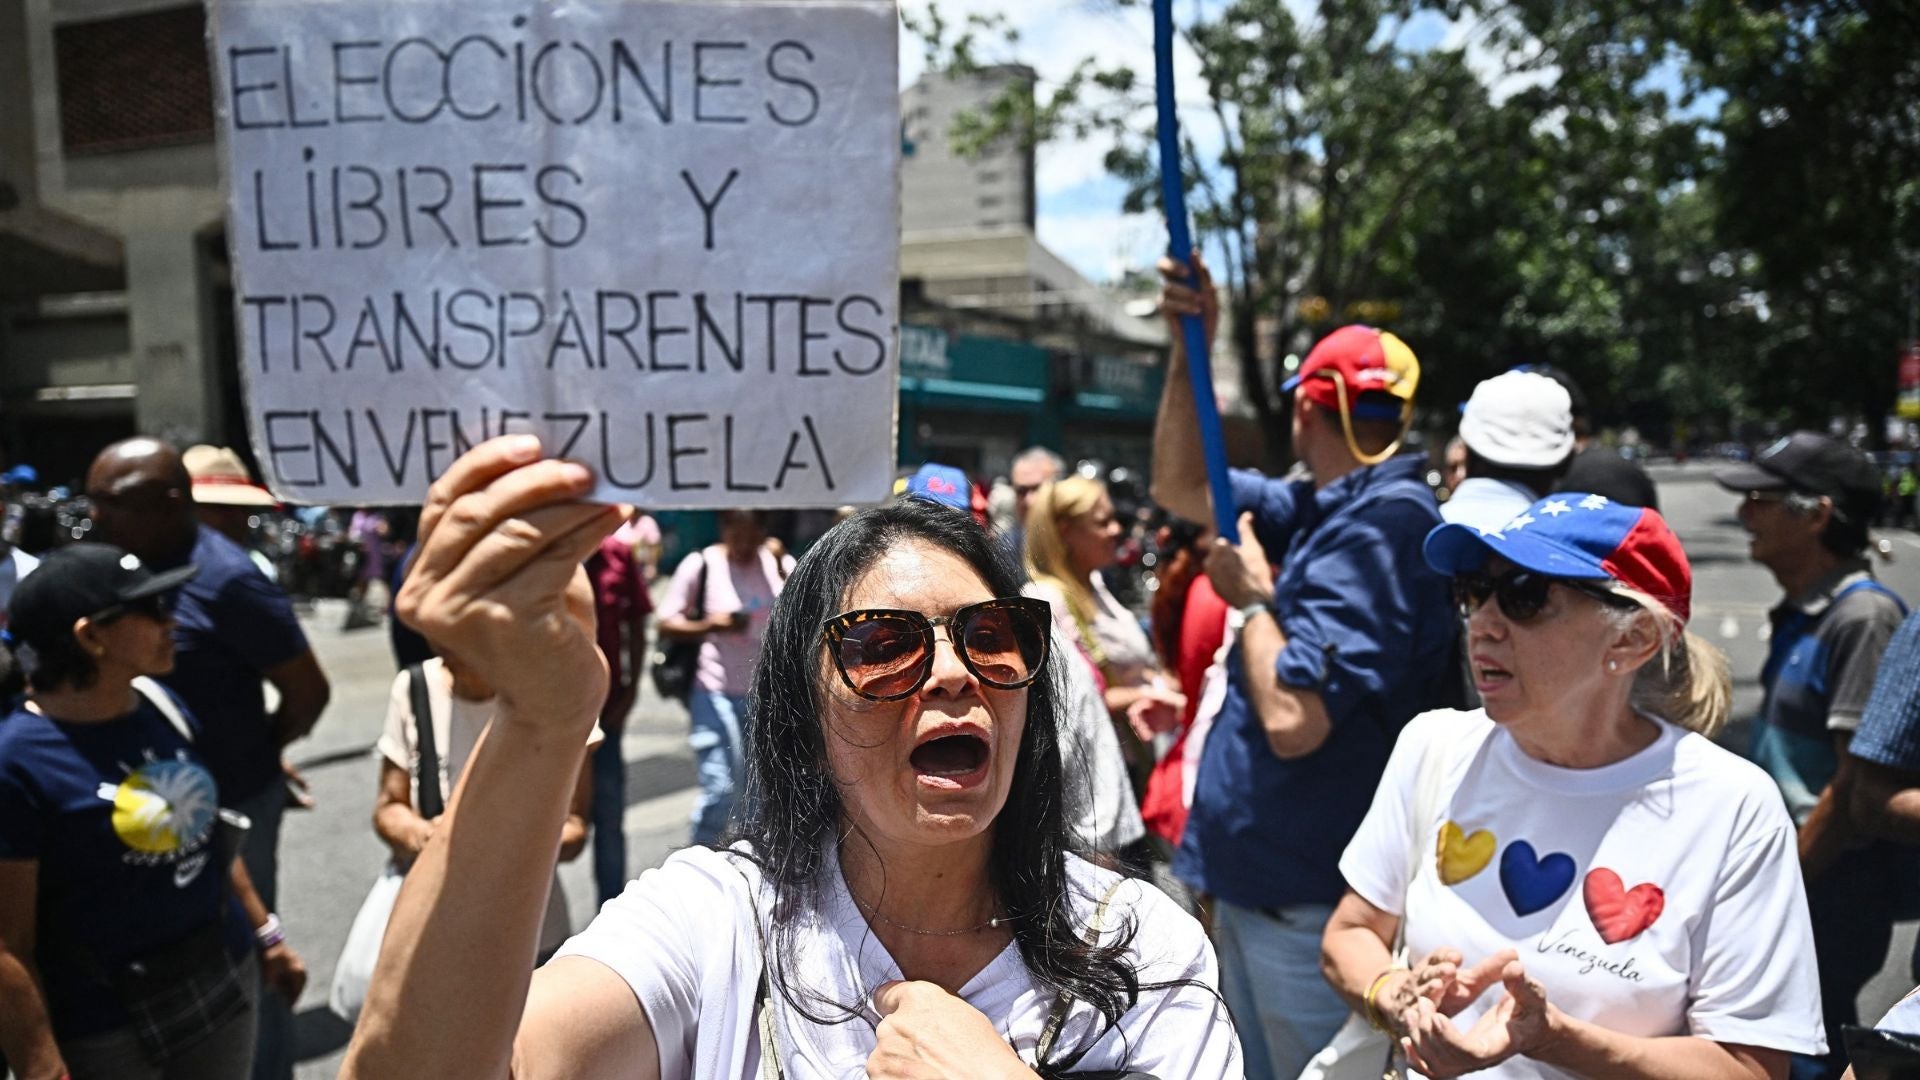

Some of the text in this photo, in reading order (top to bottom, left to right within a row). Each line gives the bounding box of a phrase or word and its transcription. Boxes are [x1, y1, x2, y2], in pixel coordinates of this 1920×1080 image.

[682, 168, 740, 250] Y
[244, 288, 887, 376] TRANSPARENTES
[264, 409, 361, 487] EN
[1537, 927, 1644, 982] Venezuela
